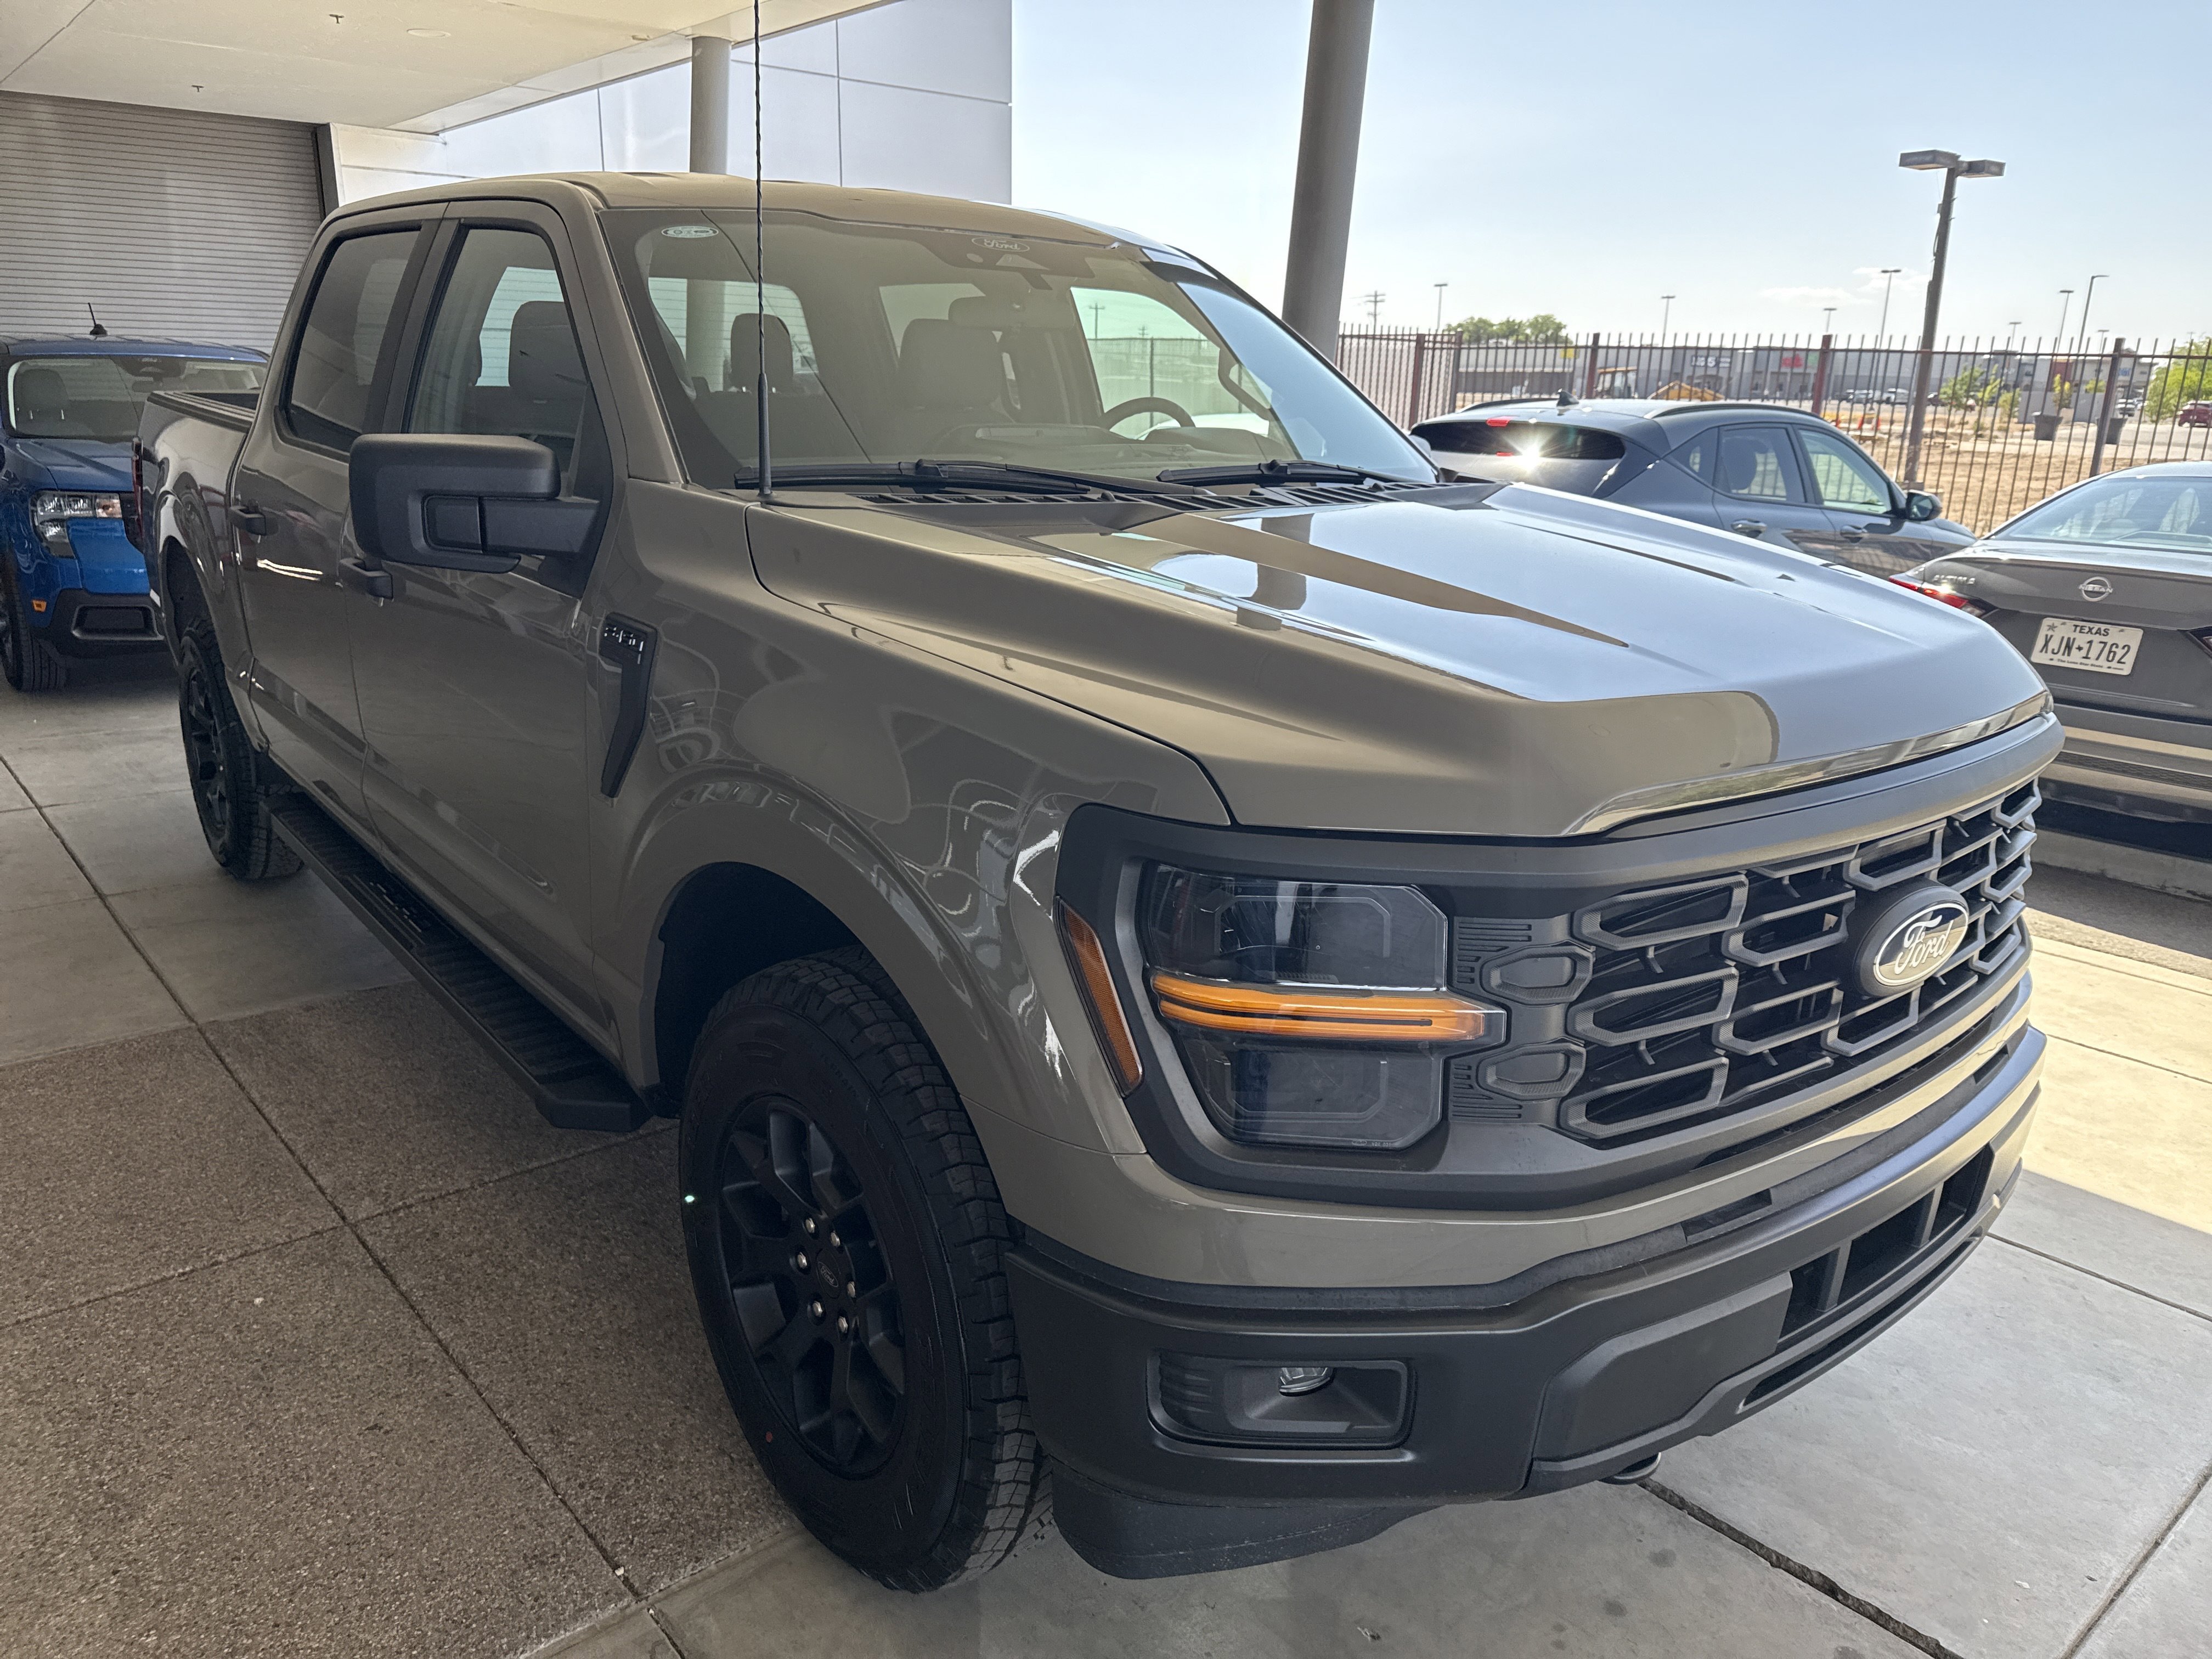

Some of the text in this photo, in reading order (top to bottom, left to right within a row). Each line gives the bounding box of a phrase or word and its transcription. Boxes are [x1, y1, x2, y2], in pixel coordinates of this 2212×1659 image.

[984, 238, 1021, 251] Ford
[2079, 583, 2113, 593] NISSAN
[2073, 624, 2111, 637] TEXAS
[1894, 915, 1954, 975] Ford
[821, 1265, 835, 1284] Ford
